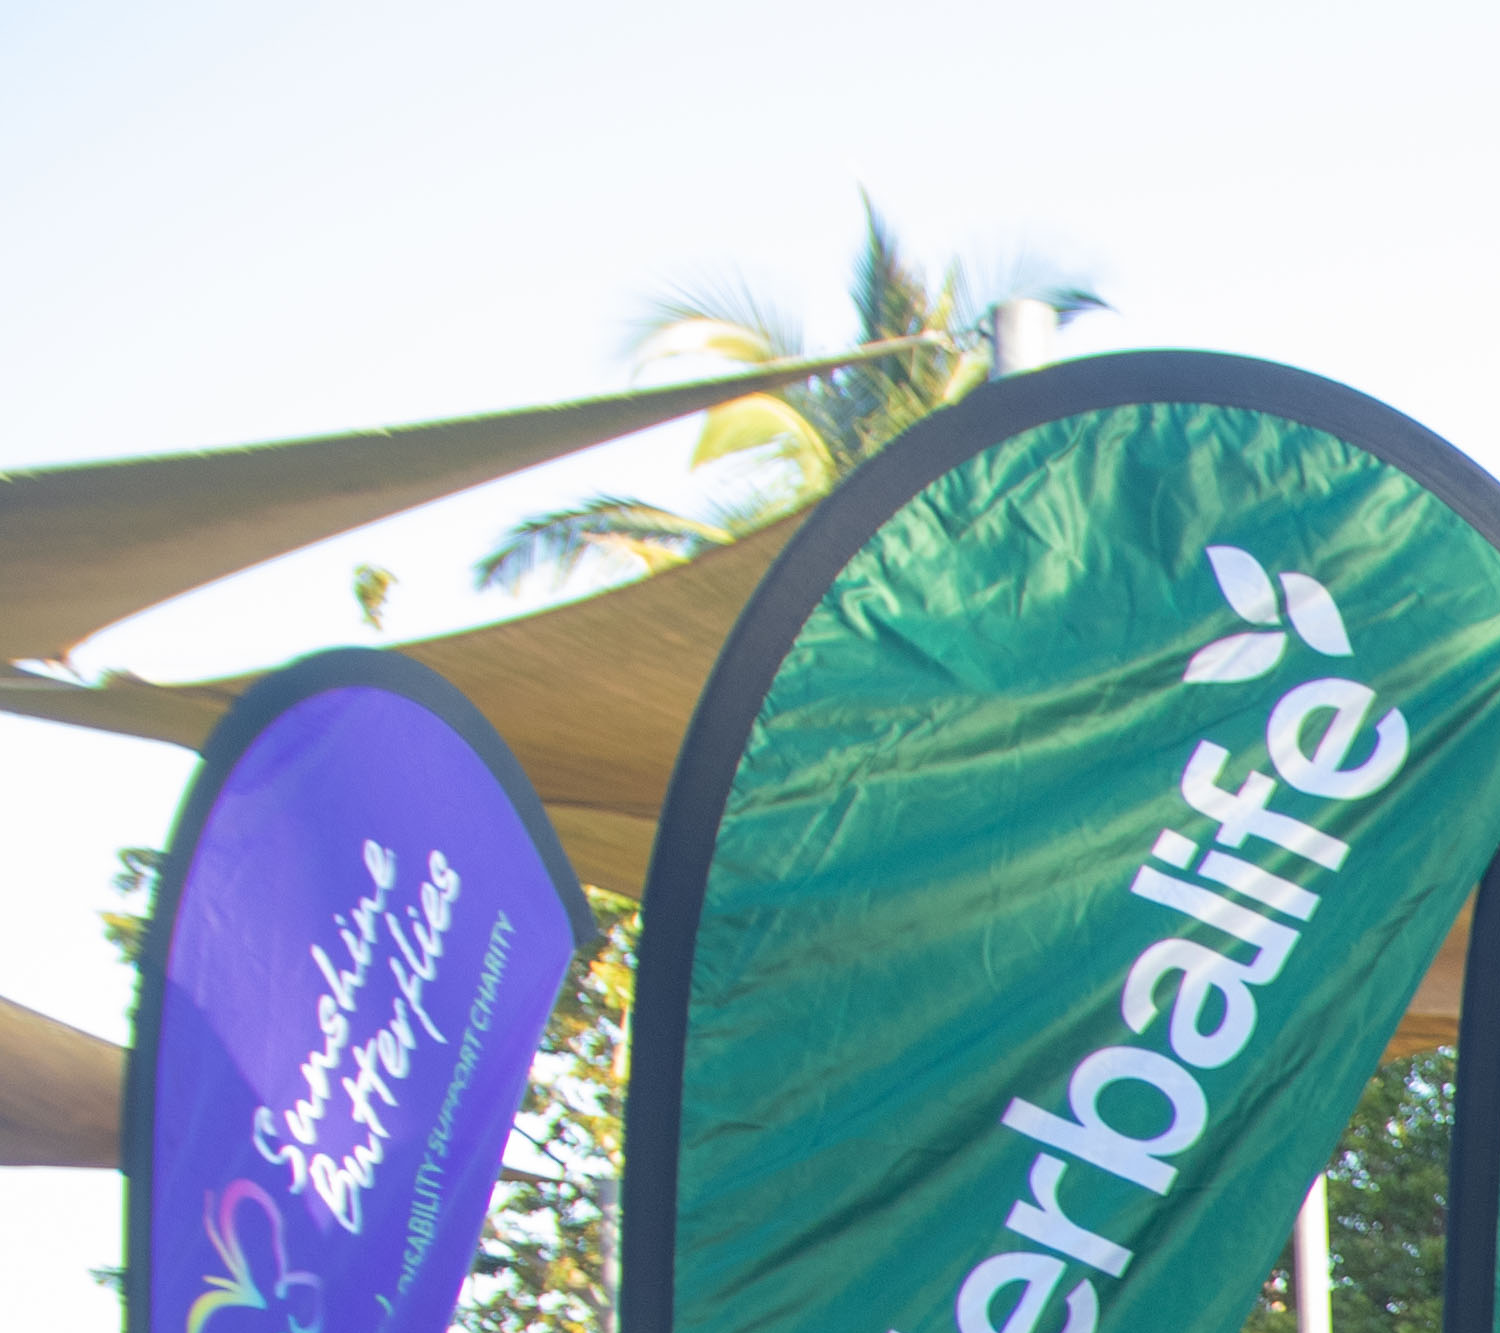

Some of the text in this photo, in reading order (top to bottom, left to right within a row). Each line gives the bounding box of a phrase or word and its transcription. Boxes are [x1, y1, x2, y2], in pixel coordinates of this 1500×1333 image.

[252, 838, 398, 1195] Sunshine
[309, 848, 463, 1234] Butterflies
[427, 1029, 485, 1156] SUPPORT
[469, 910, 517, 1033] CHARITY
